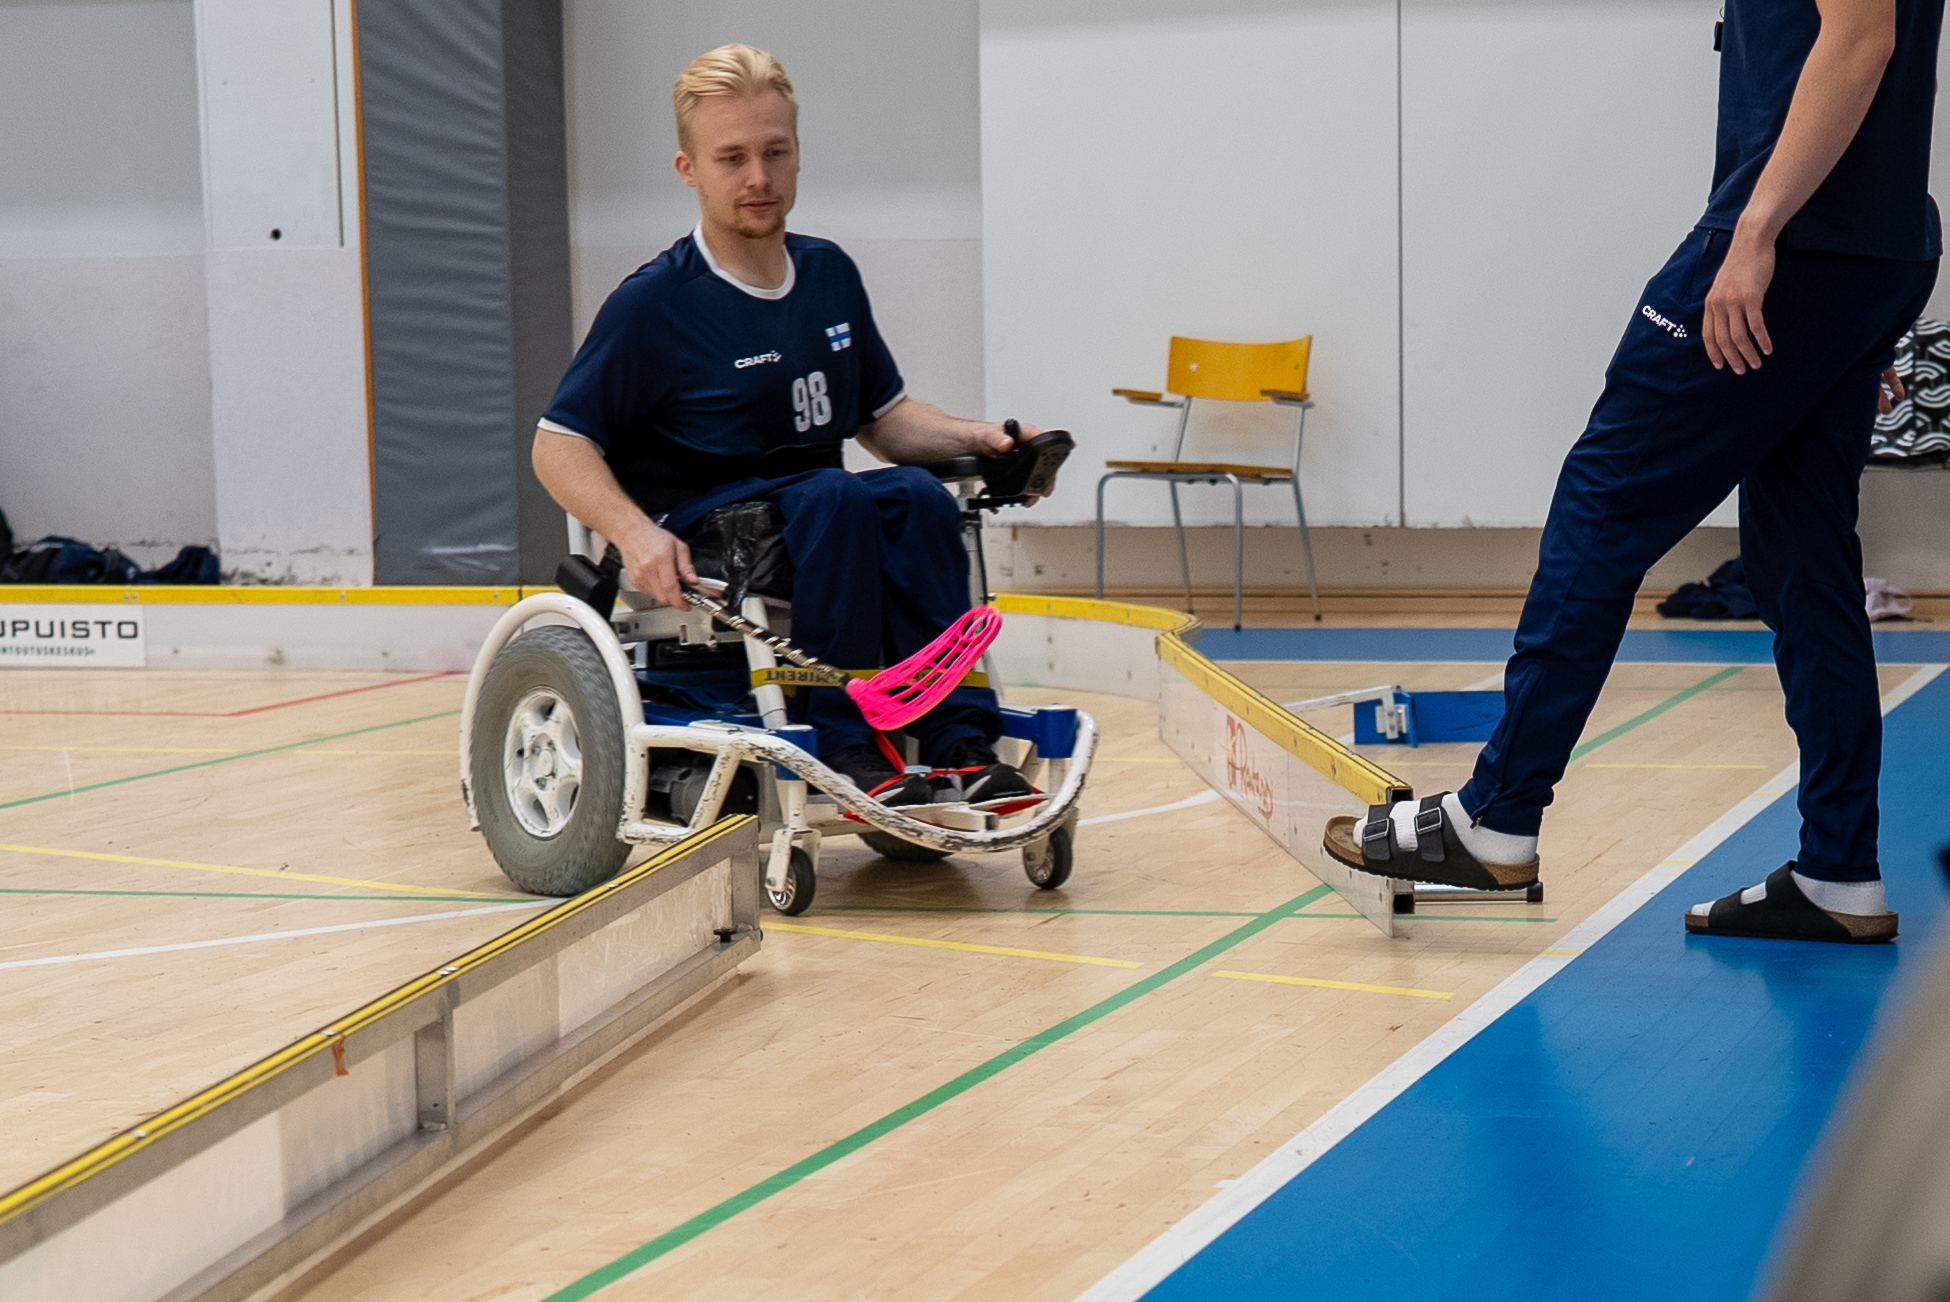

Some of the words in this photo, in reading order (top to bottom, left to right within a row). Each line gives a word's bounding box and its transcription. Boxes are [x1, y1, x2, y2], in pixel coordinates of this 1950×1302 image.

[1642, 305, 1677, 331] CRAFT
[734, 353, 773, 369] CRAFT
[791, 371, 832, 432] 98
[765, 670, 828, 684] MIRENT
